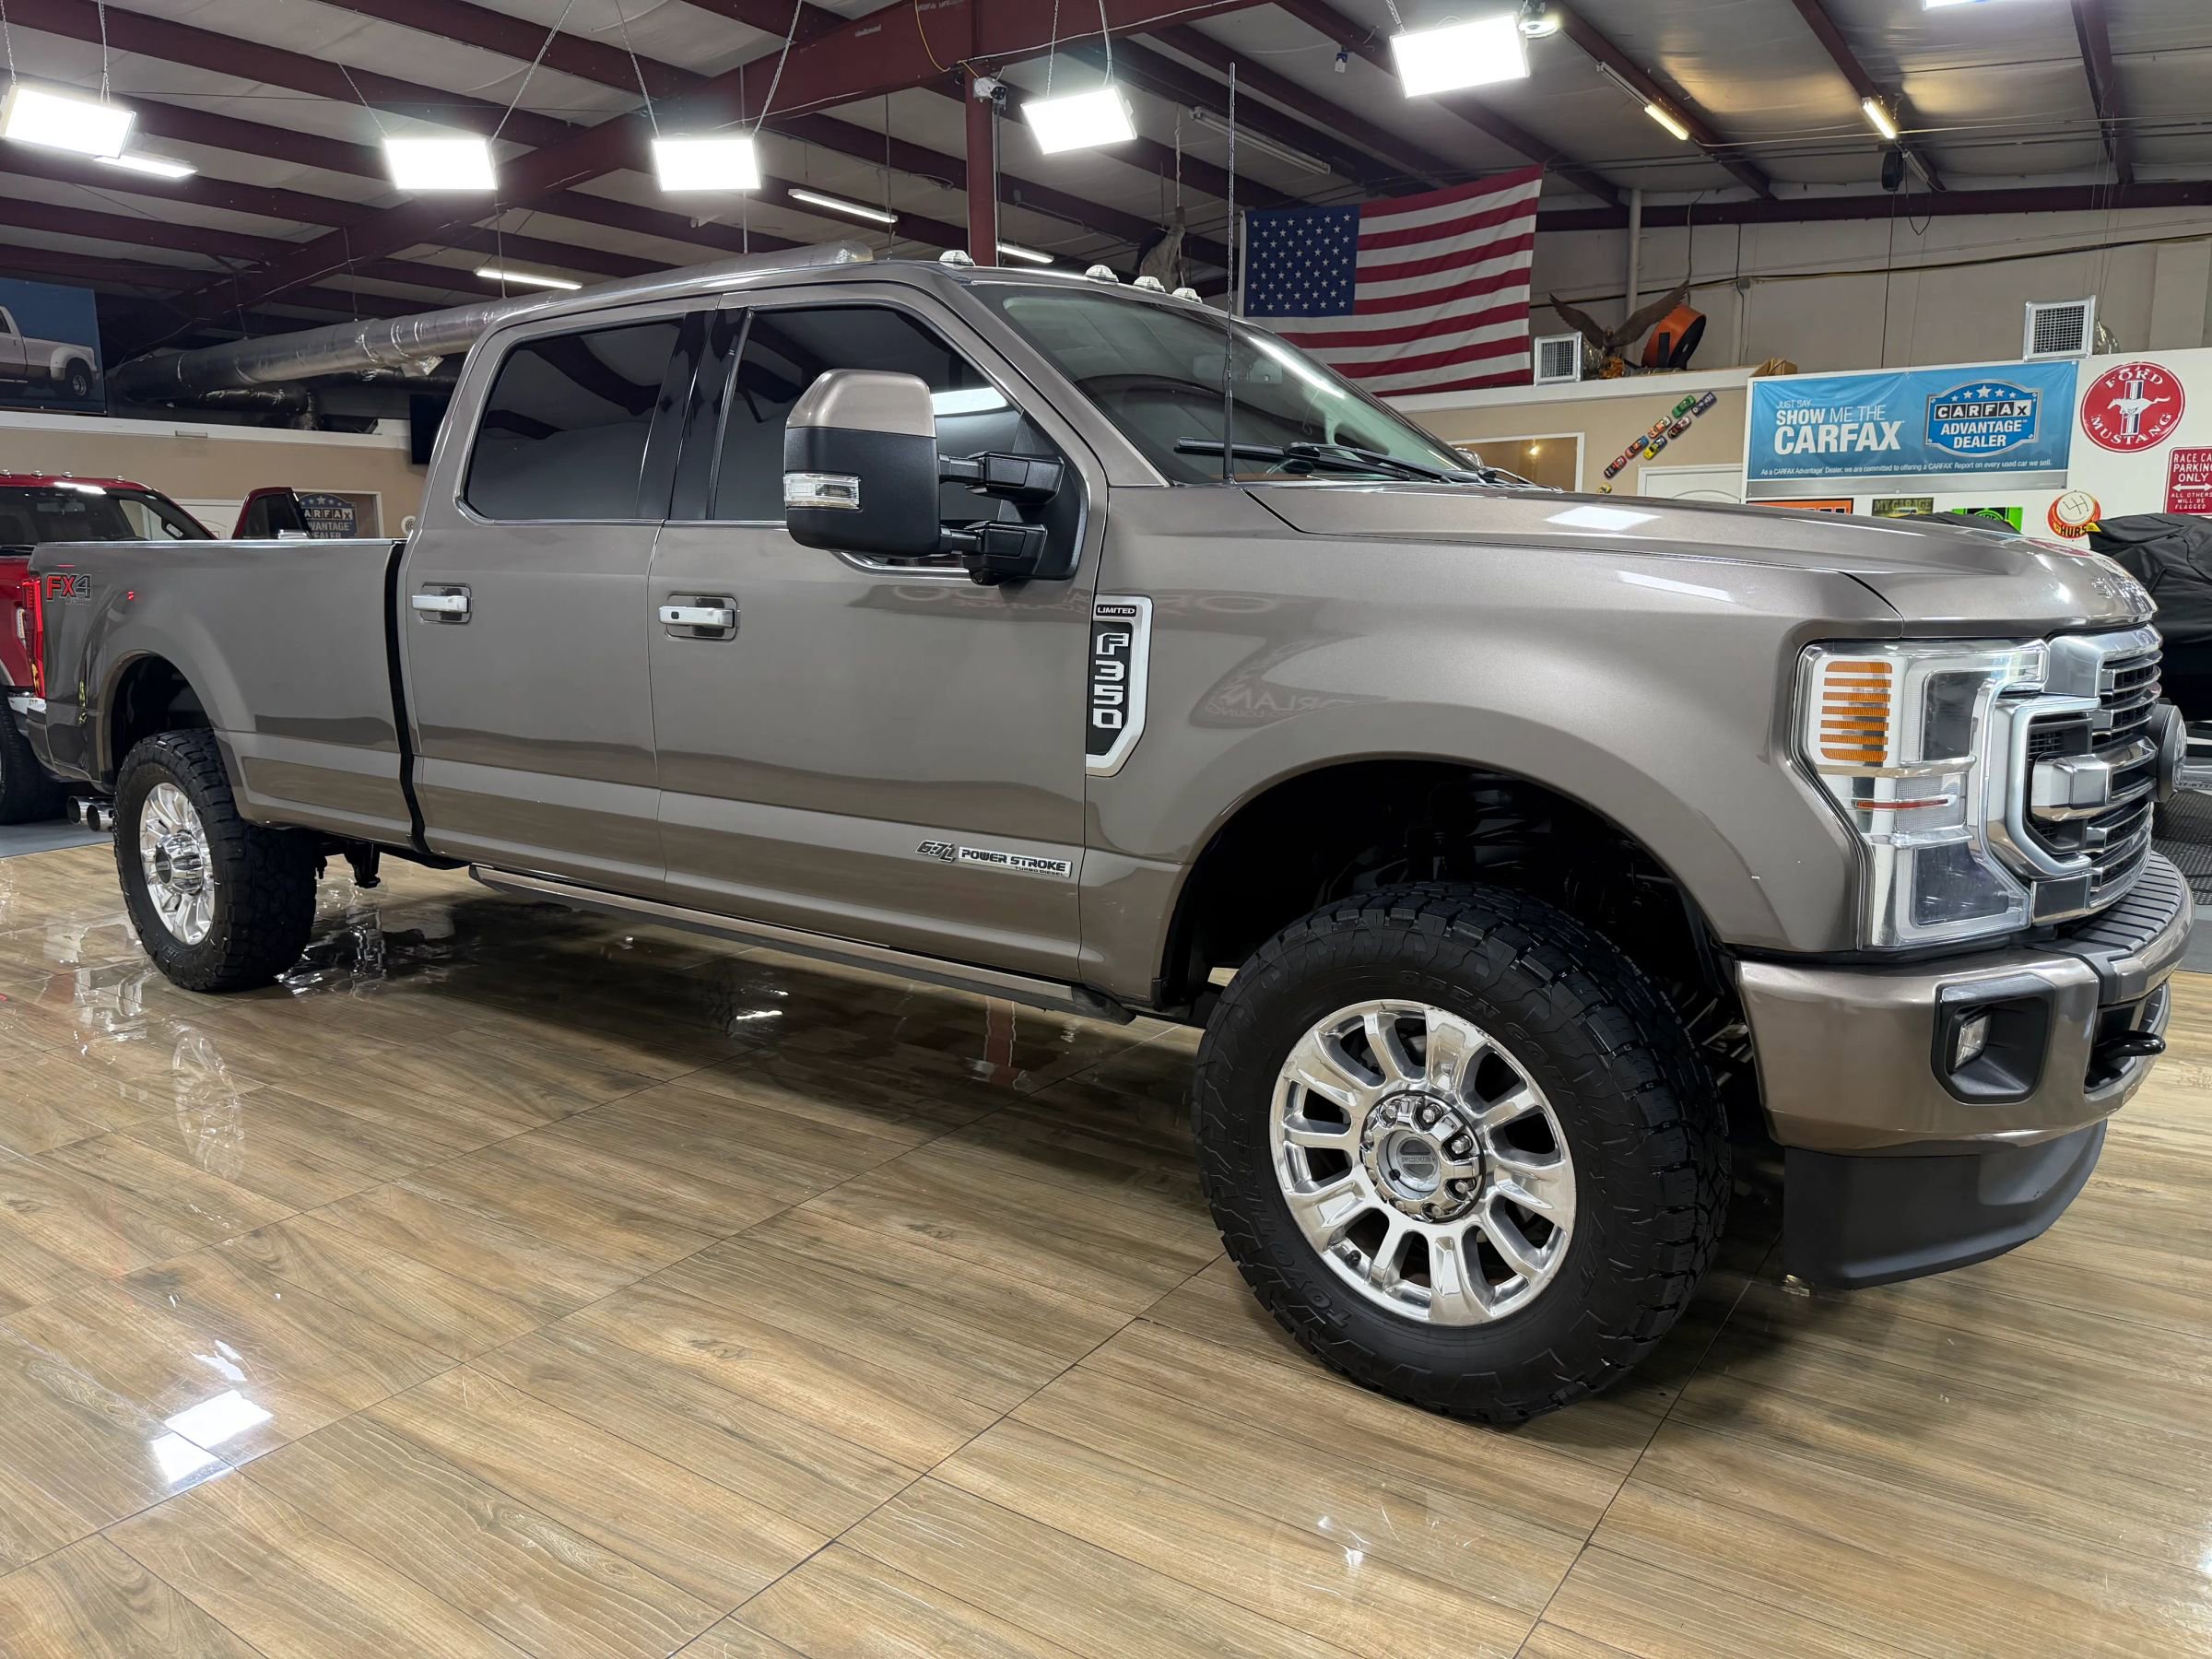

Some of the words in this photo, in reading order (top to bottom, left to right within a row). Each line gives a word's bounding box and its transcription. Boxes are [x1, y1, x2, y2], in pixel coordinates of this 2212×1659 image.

[2105, 368, 2163, 388] FORD
[1777, 400, 1795, 409] JUST
[1936, 402, 2029, 418] CARFAX
[1776, 408, 1826, 425] SHOW
[1830, 406, 1853, 423] ME
[1858, 405, 1887, 421] THE
[1940, 419, 2022, 435] ADVANTAGE
[2090, 413, 2171, 444] MUSTANG
[1774, 421, 1901, 454] CARFAX
[1953, 434, 2006, 449] DEALER
[2173, 453, 2197, 463] RACE
[2200, 453, 2212, 462] CA
[1864, 465, 1892, 473] committed
[1900, 464, 1922, 472] offering
[1928, 462, 1951, 470] CARFAX
[1954, 462, 1973, 470] Report
[2178, 472, 2209, 483] ONLY
[1874, 500, 1890, 512] MY
[1891, 498, 1933, 511] GARAGE
[304, 509, 352, 520] ARFAX
[309, 522, 350, 531] VANTAGE
[2061, 524, 2087, 537] HURS
[46, 572, 92, 601] FX4
[1097, 606, 1135, 615] LIMITED
[1092, 632, 1130, 729] F350
[961, 849, 1007, 864] POWER
[1010, 855, 1066, 872] STROKE
[1269, 1241, 1353, 1329] TOYO
